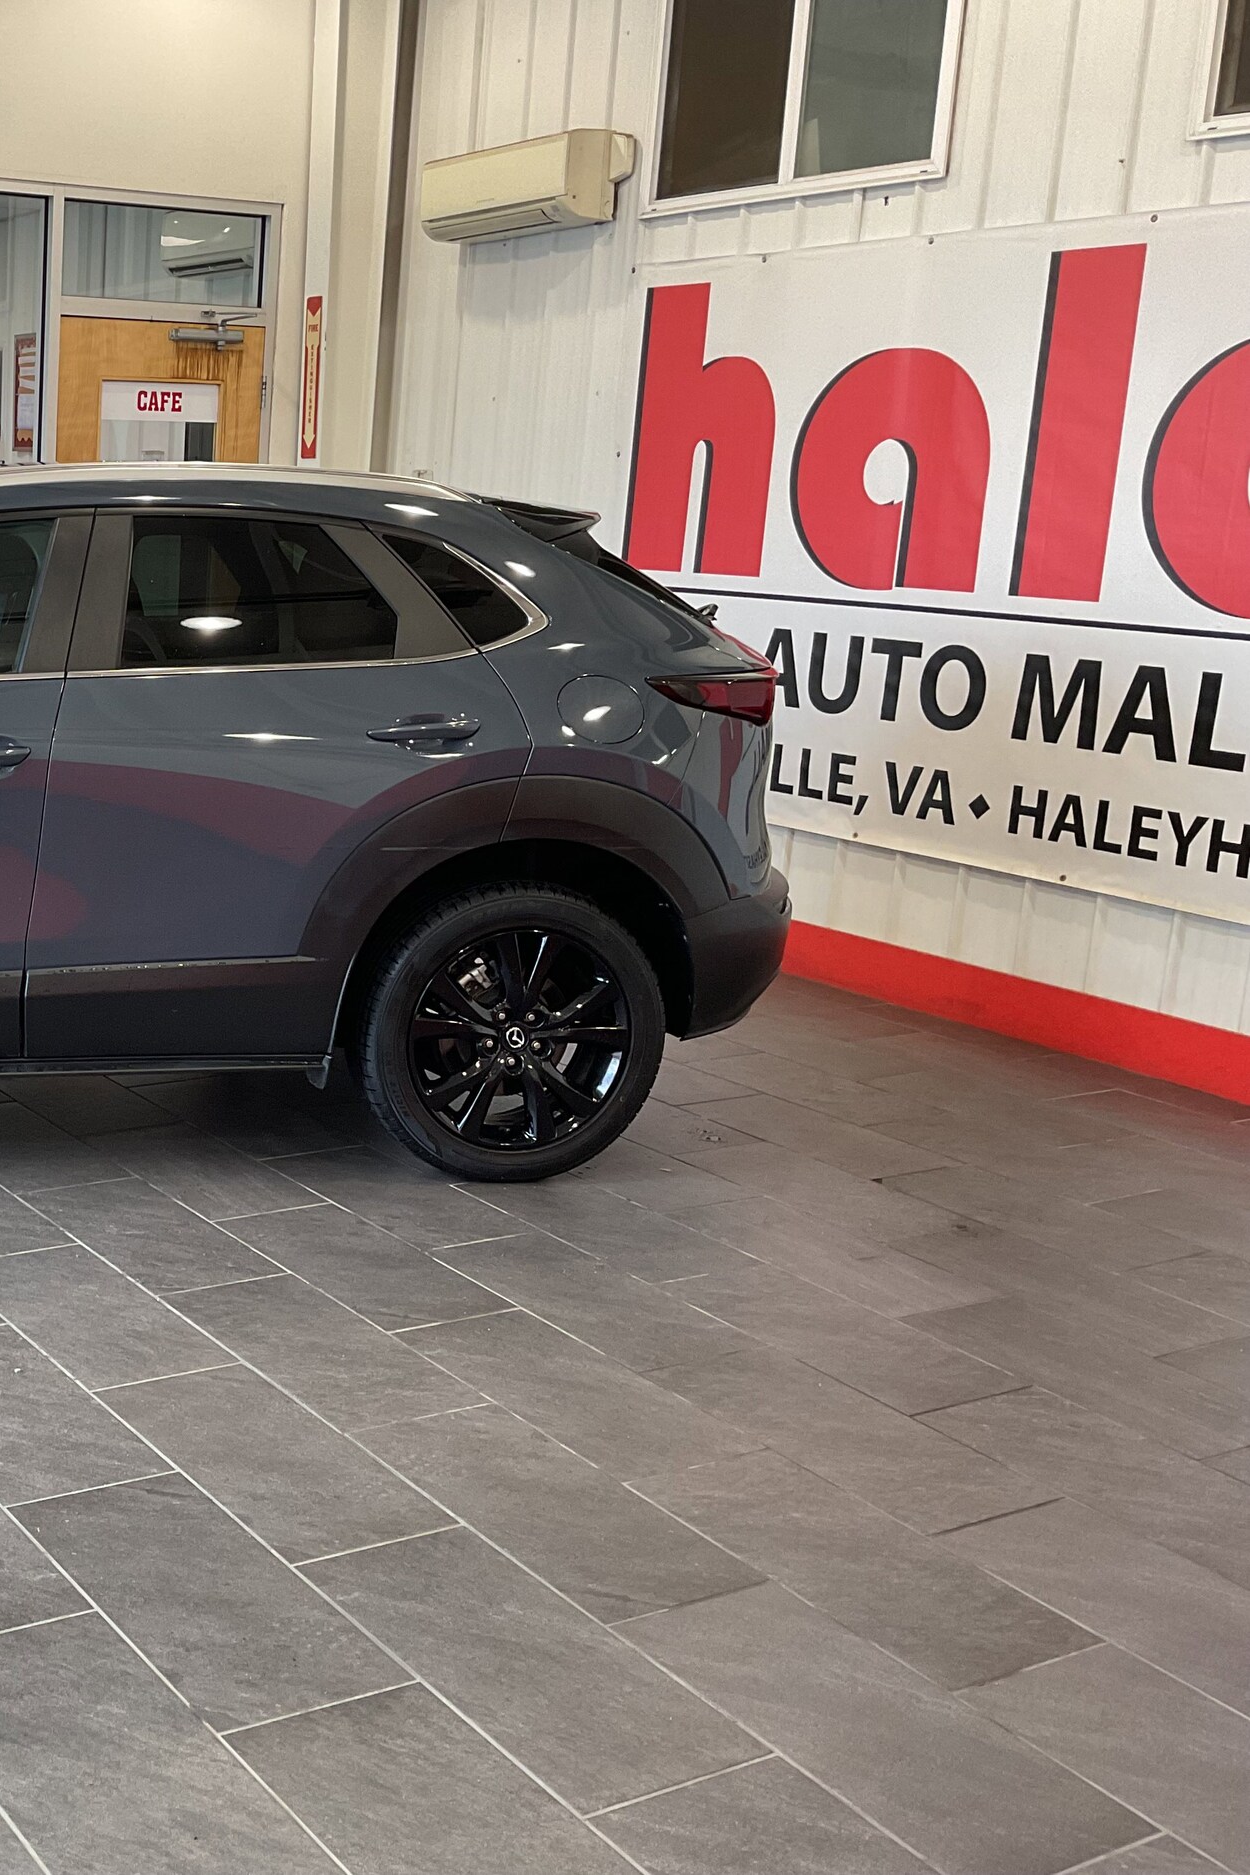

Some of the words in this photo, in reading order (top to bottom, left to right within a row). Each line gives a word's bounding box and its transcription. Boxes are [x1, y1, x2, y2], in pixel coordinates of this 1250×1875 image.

[308, 324, 318, 332] FIRE
[136, 390, 183, 412] CAFE
[763, 627, 987, 731] AUTO
[886, 761, 955, 825] VA
